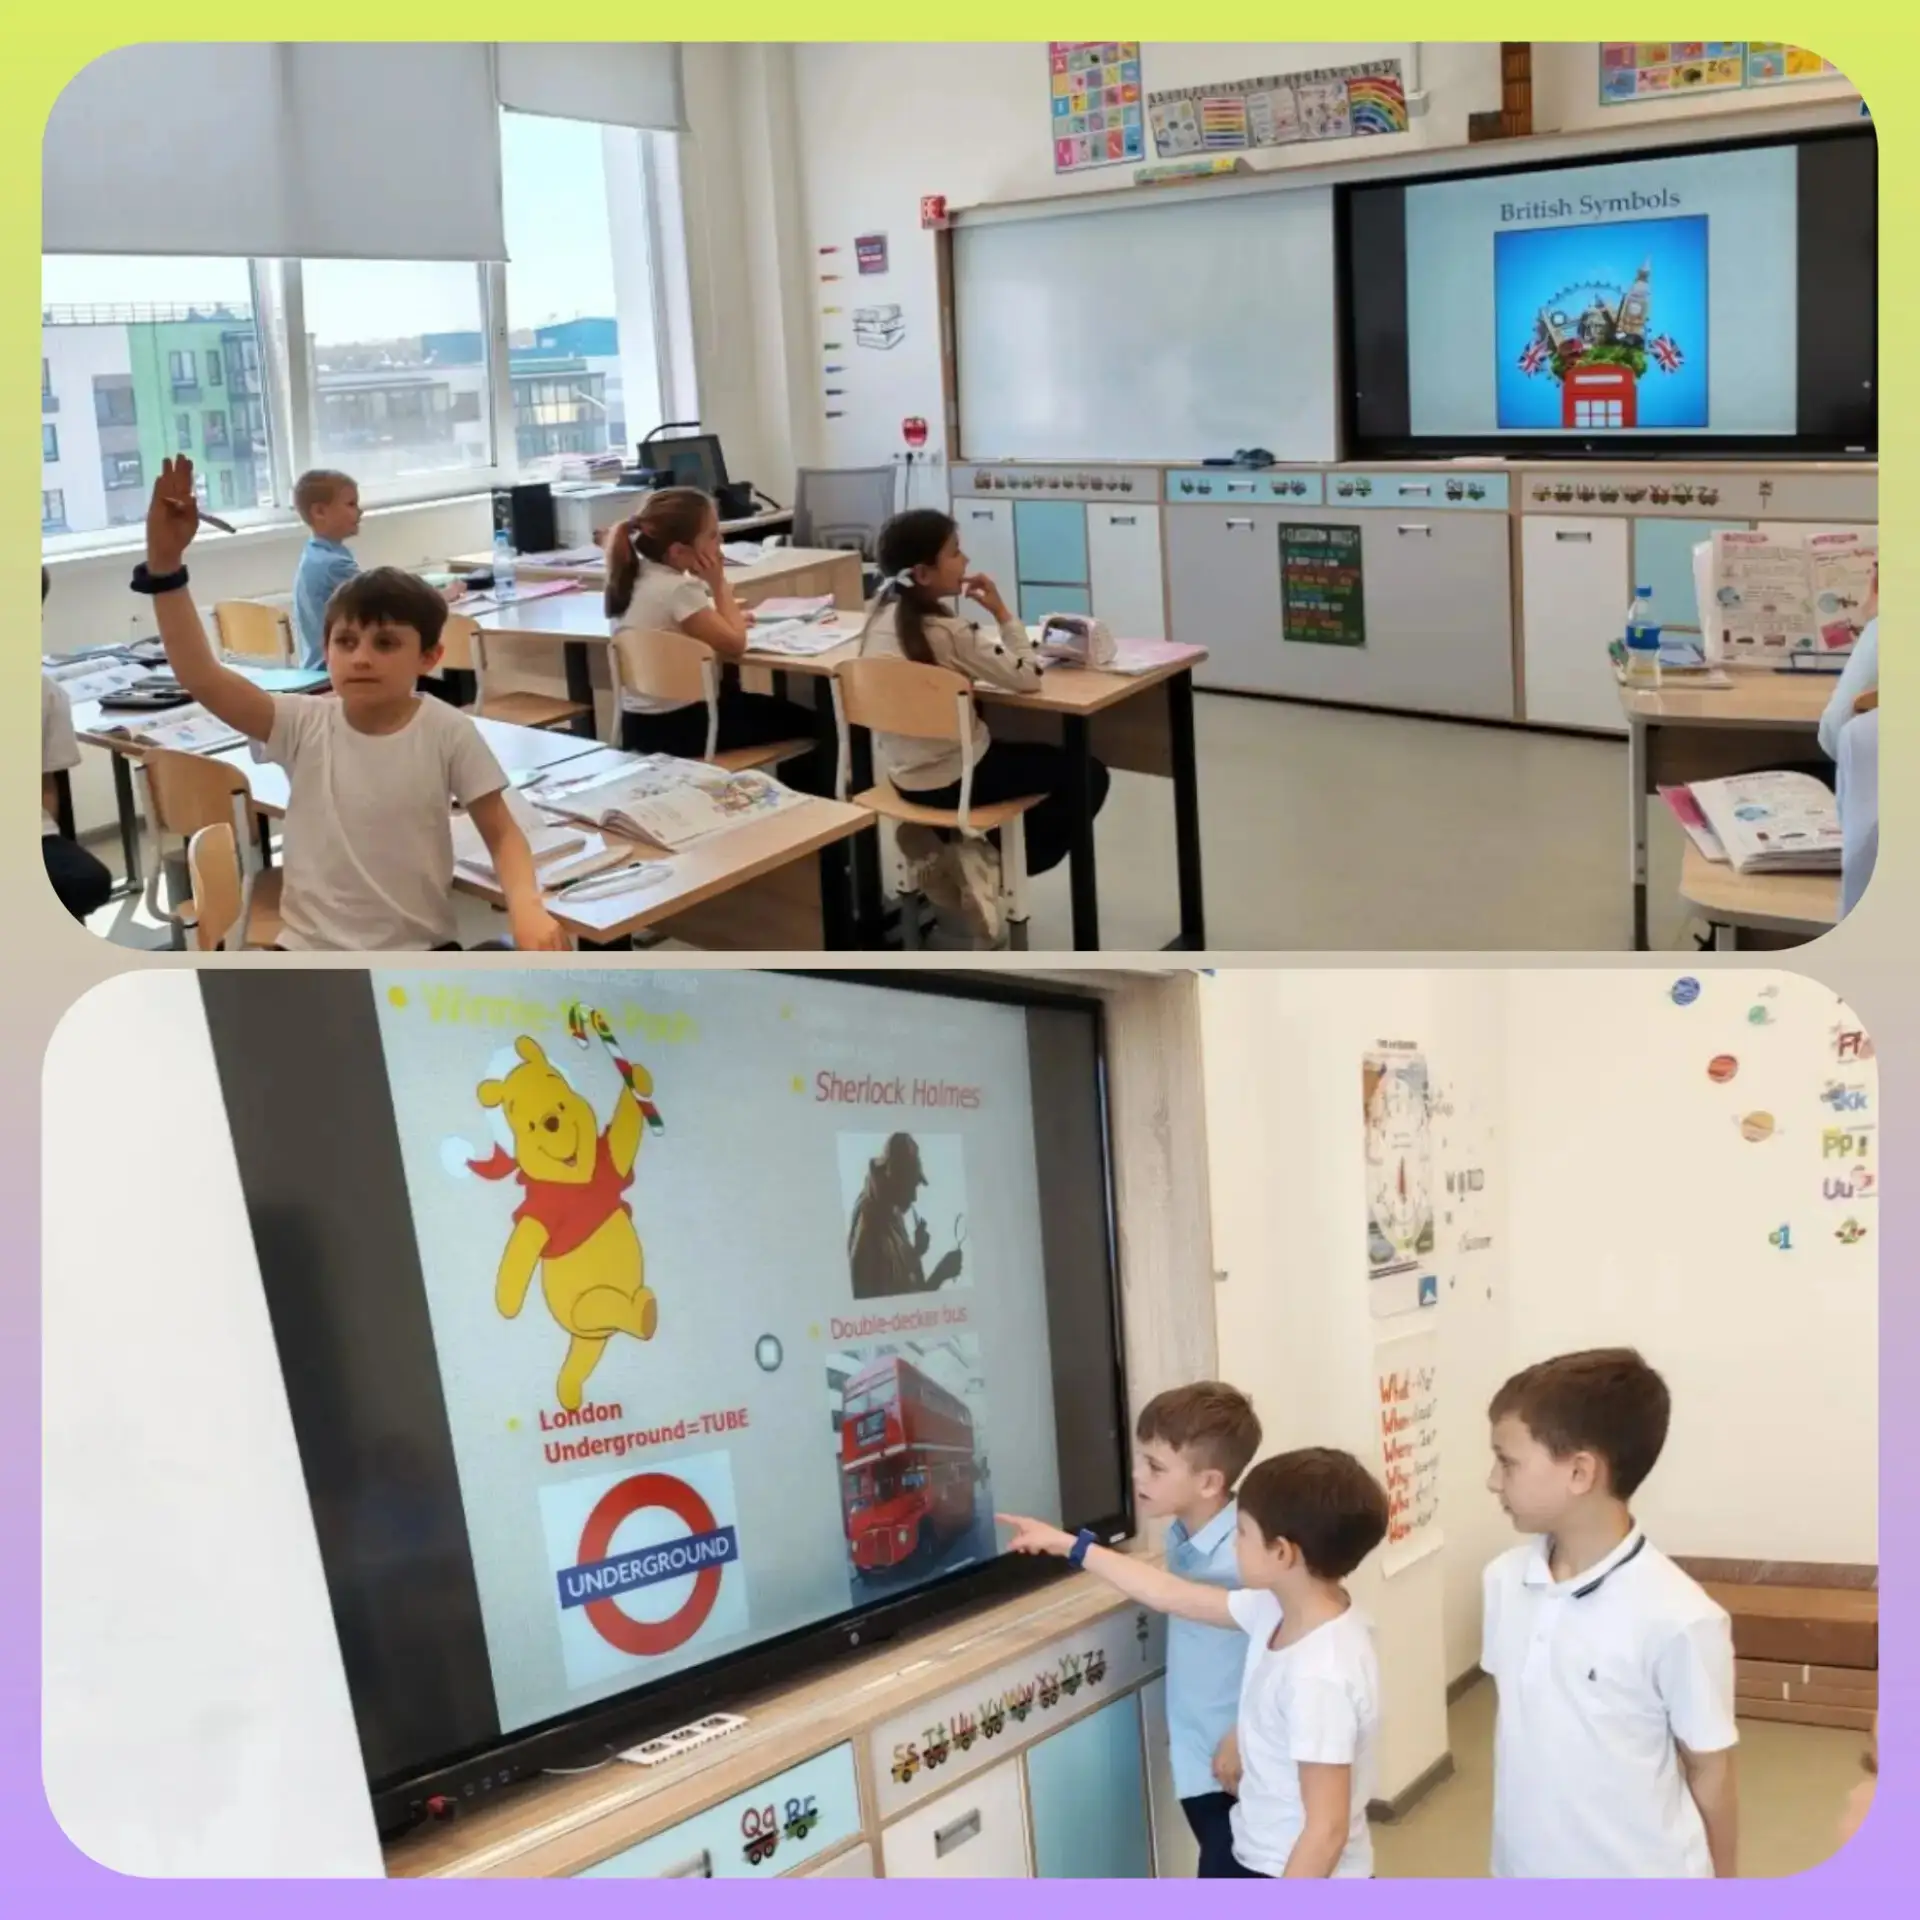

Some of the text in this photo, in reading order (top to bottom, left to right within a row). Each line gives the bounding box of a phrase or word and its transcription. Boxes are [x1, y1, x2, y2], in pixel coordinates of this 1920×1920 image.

[1500, 188, 1681, 222] British Symbols
[815, 1070, 982, 1108] Sherlock Holmes
[830, 1305, 968, 1340] Double-decker bus
[539, 1402, 623, 1431] London
[544, 1408, 749, 1463] Underground=TUBE
[566, 1536, 730, 1597] UNDERGROUND
[741, 1804, 776, 1840] Qq
